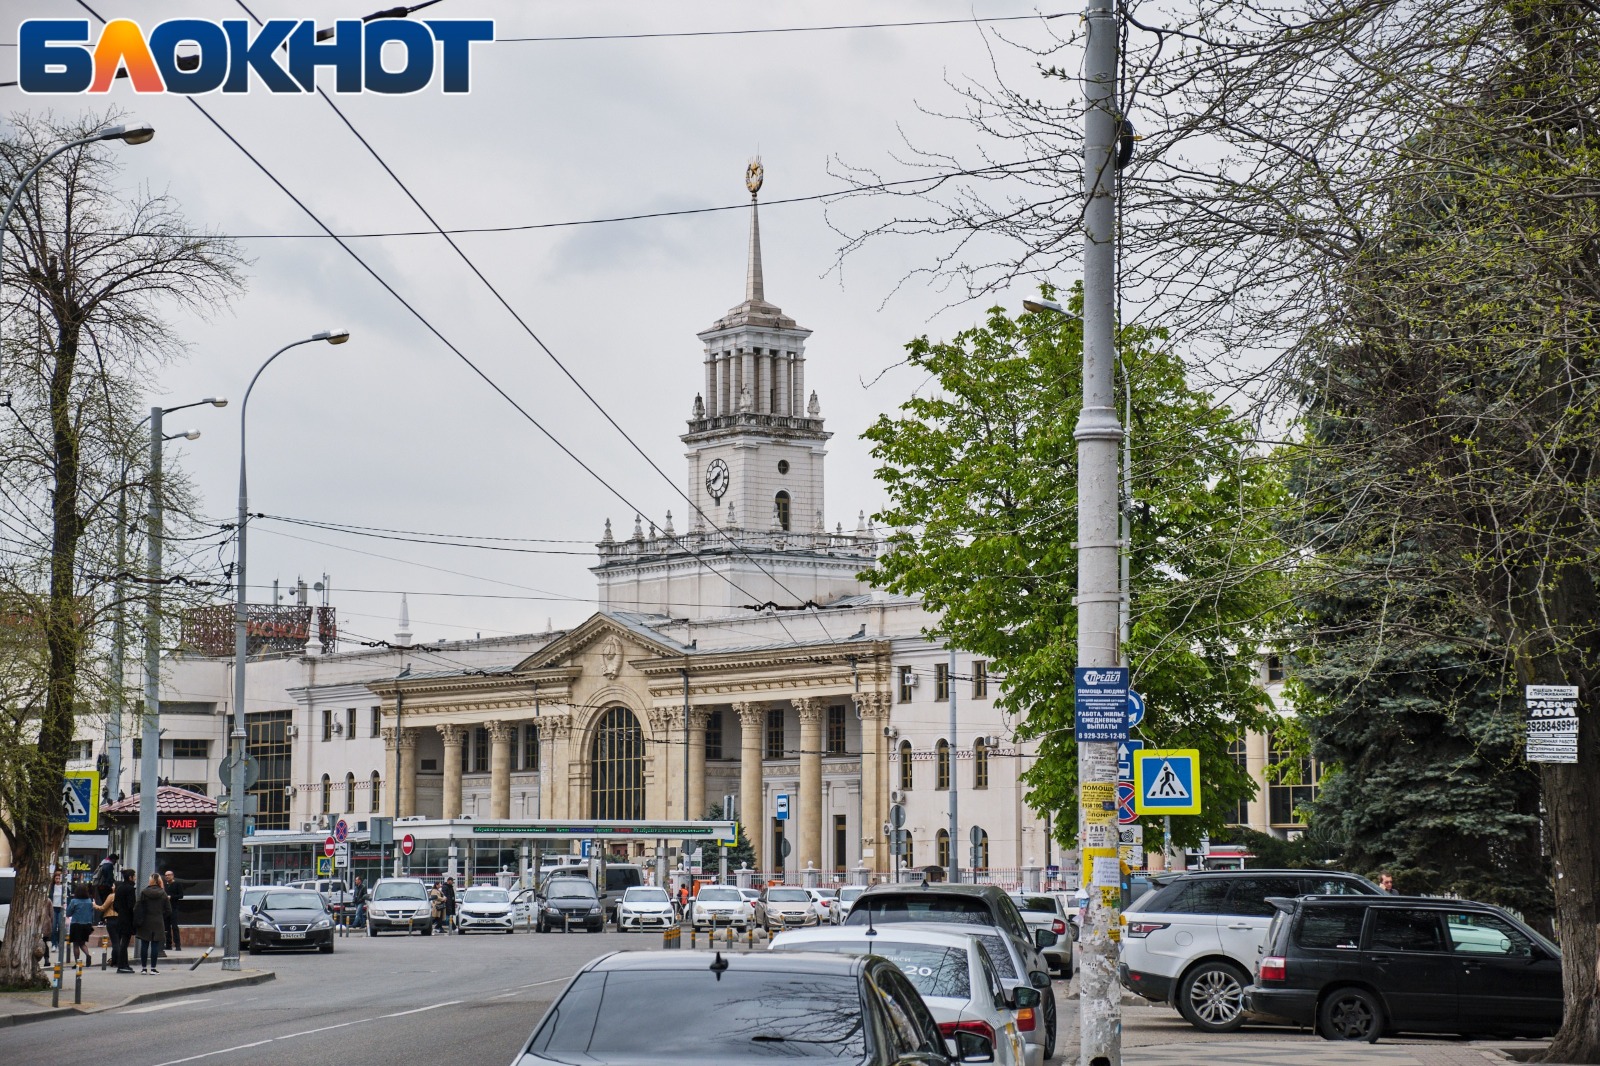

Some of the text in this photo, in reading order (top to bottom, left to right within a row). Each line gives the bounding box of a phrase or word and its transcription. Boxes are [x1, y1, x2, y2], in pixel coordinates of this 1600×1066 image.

[1089, 674, 1121, 682] ПРЕДЕЛ
[1532, 708, 1576, 717] ДОМ
[166, 819, 198, 828] ТУАЛЕТ
